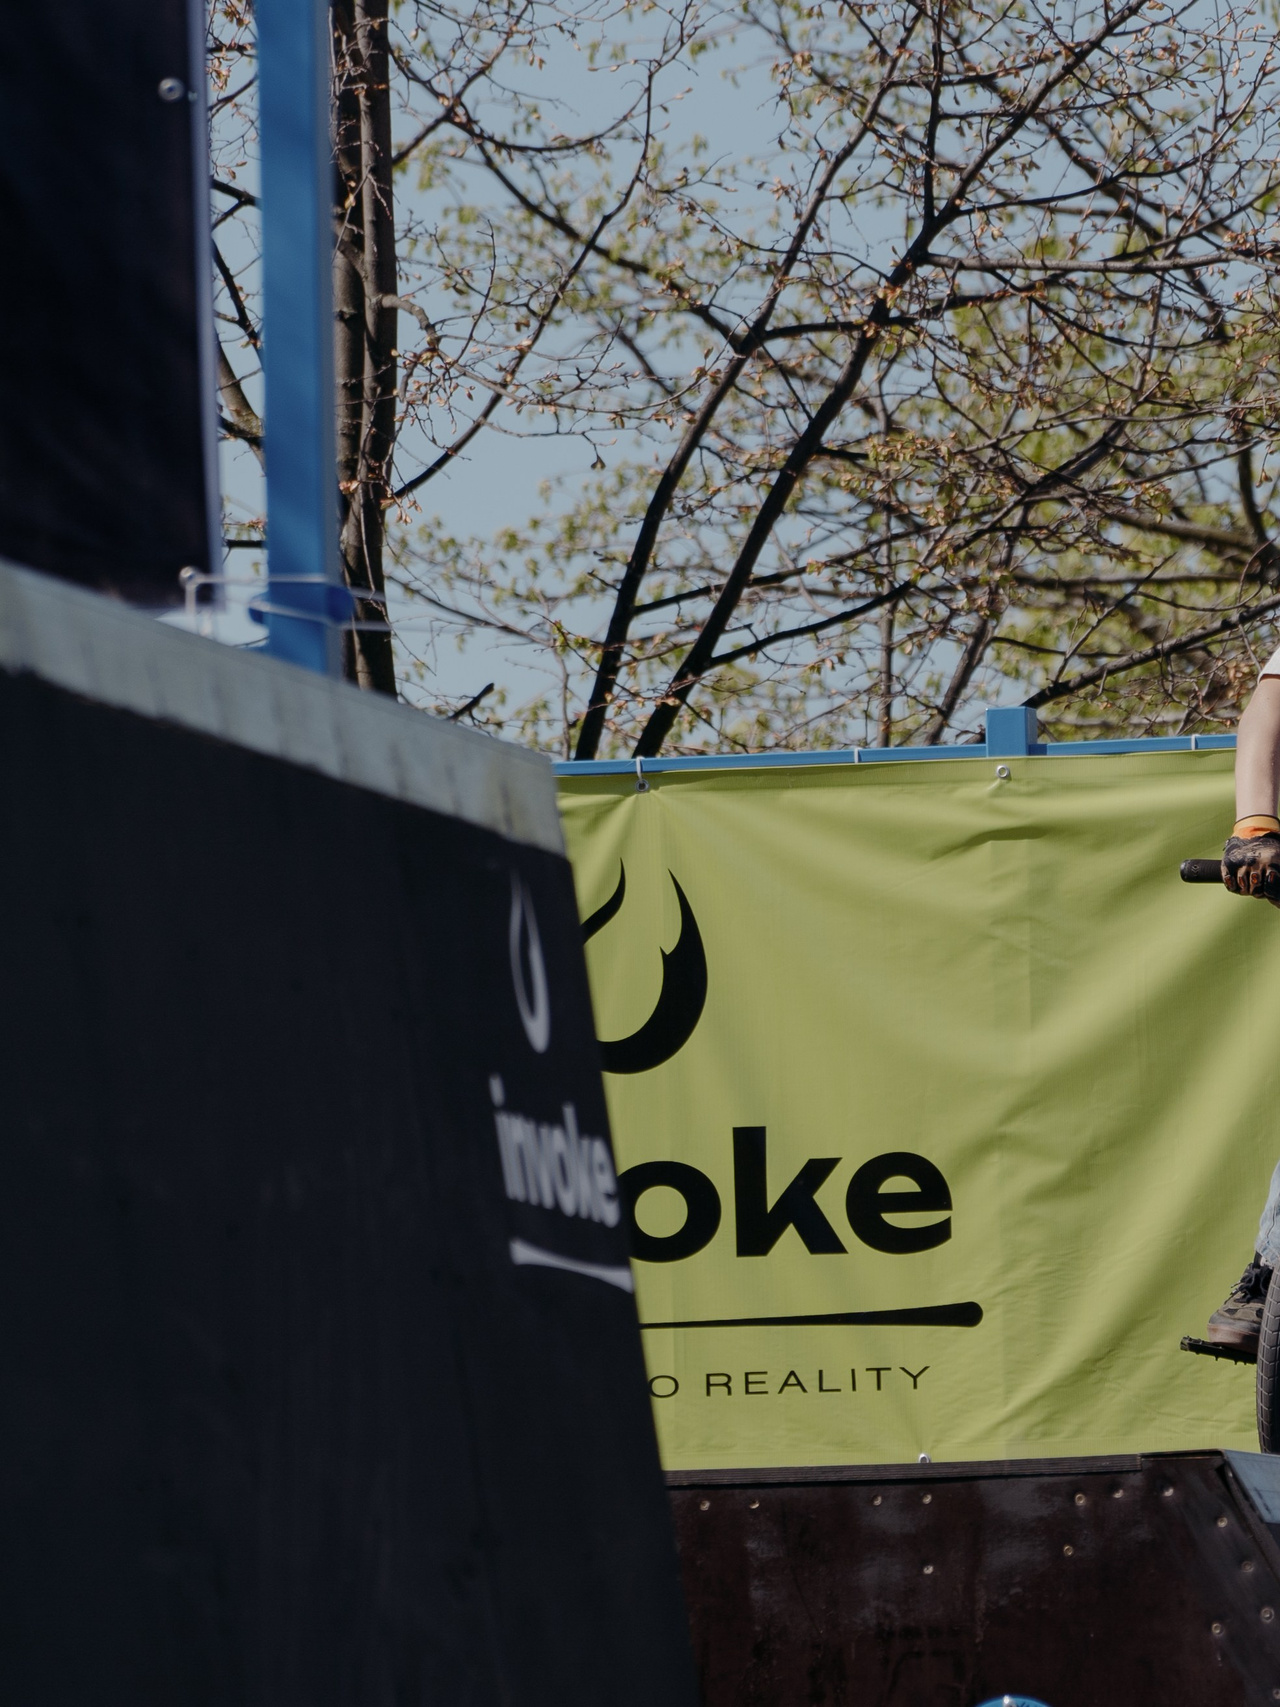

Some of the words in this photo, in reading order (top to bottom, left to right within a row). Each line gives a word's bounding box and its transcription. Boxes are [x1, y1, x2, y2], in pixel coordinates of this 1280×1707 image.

[489, 1074, 620, 1228] invoke
[617, 1126, 953, 1263] oke
[705, 1366, 931, 1397] REALITY
